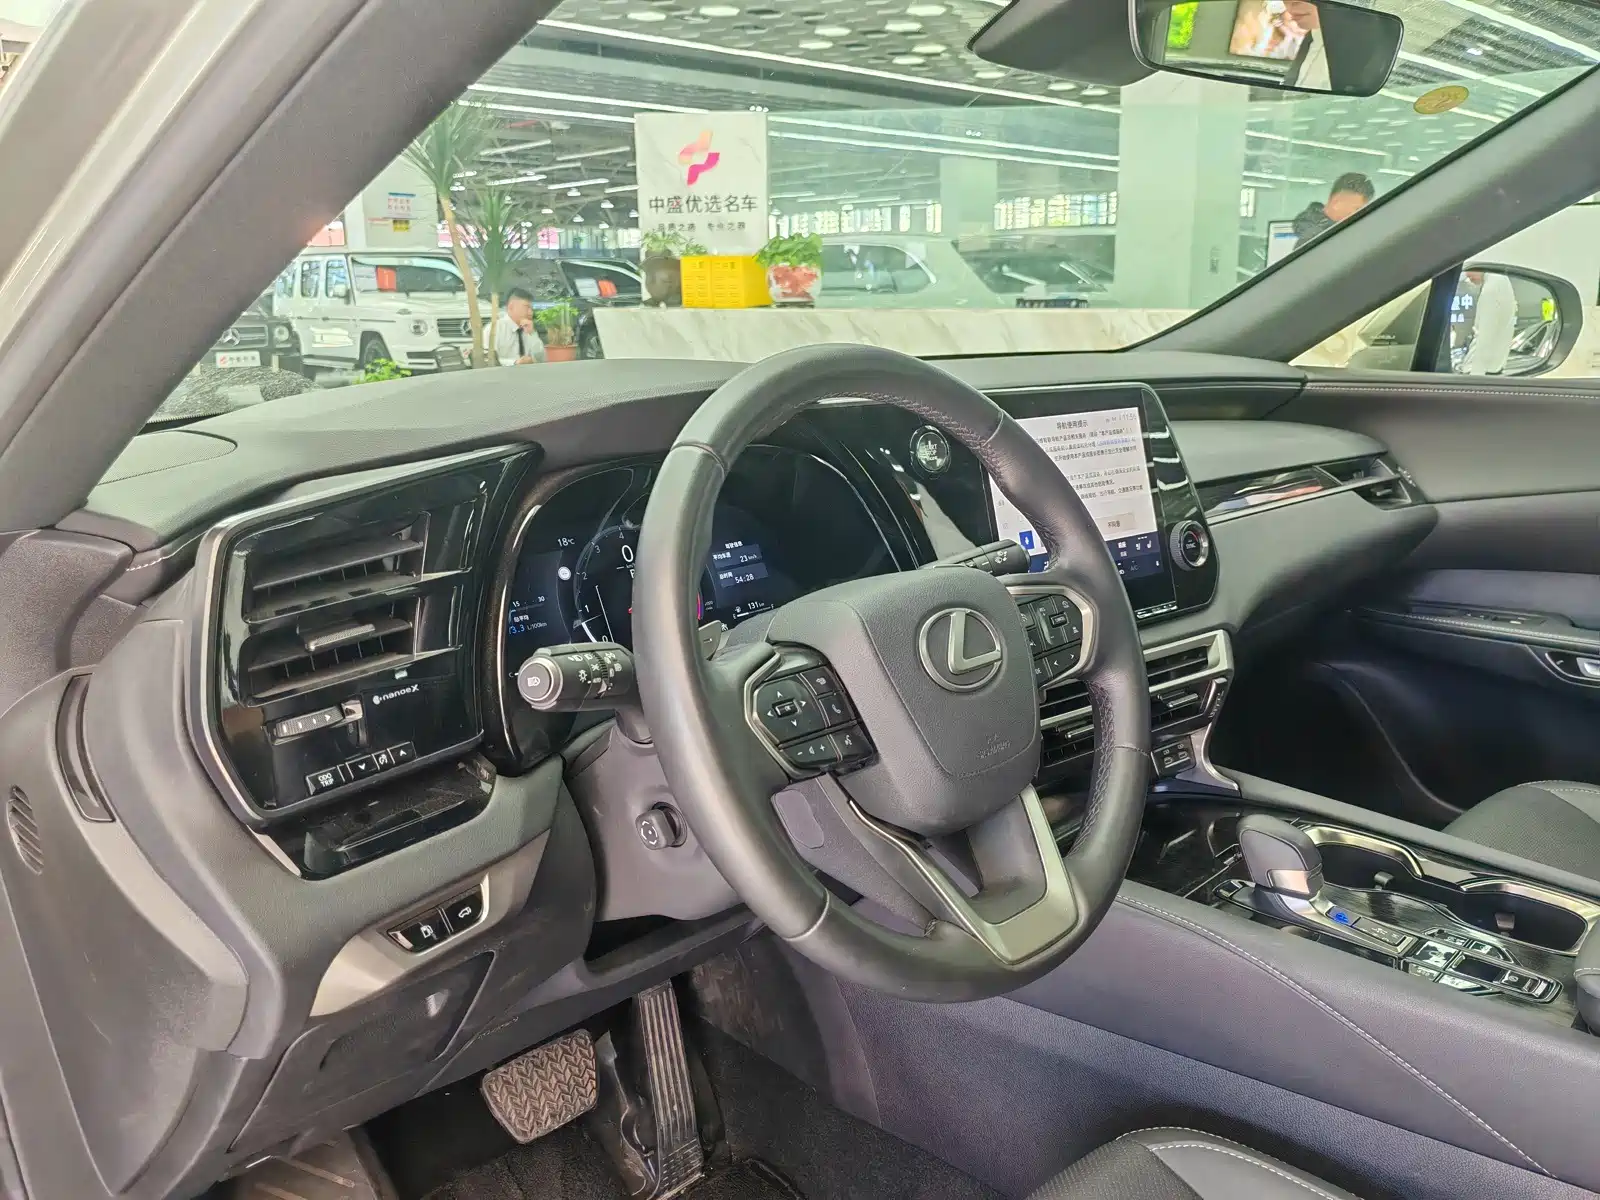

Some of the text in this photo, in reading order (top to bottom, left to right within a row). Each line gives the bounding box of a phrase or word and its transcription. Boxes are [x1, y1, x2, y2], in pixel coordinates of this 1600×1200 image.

[648, 194, 758, 214] 中盛优选名车
[621, 544, 634, 563] 0
[318, 773, 332, 782] ODO
[321, 778, 334, 787] TRIP
